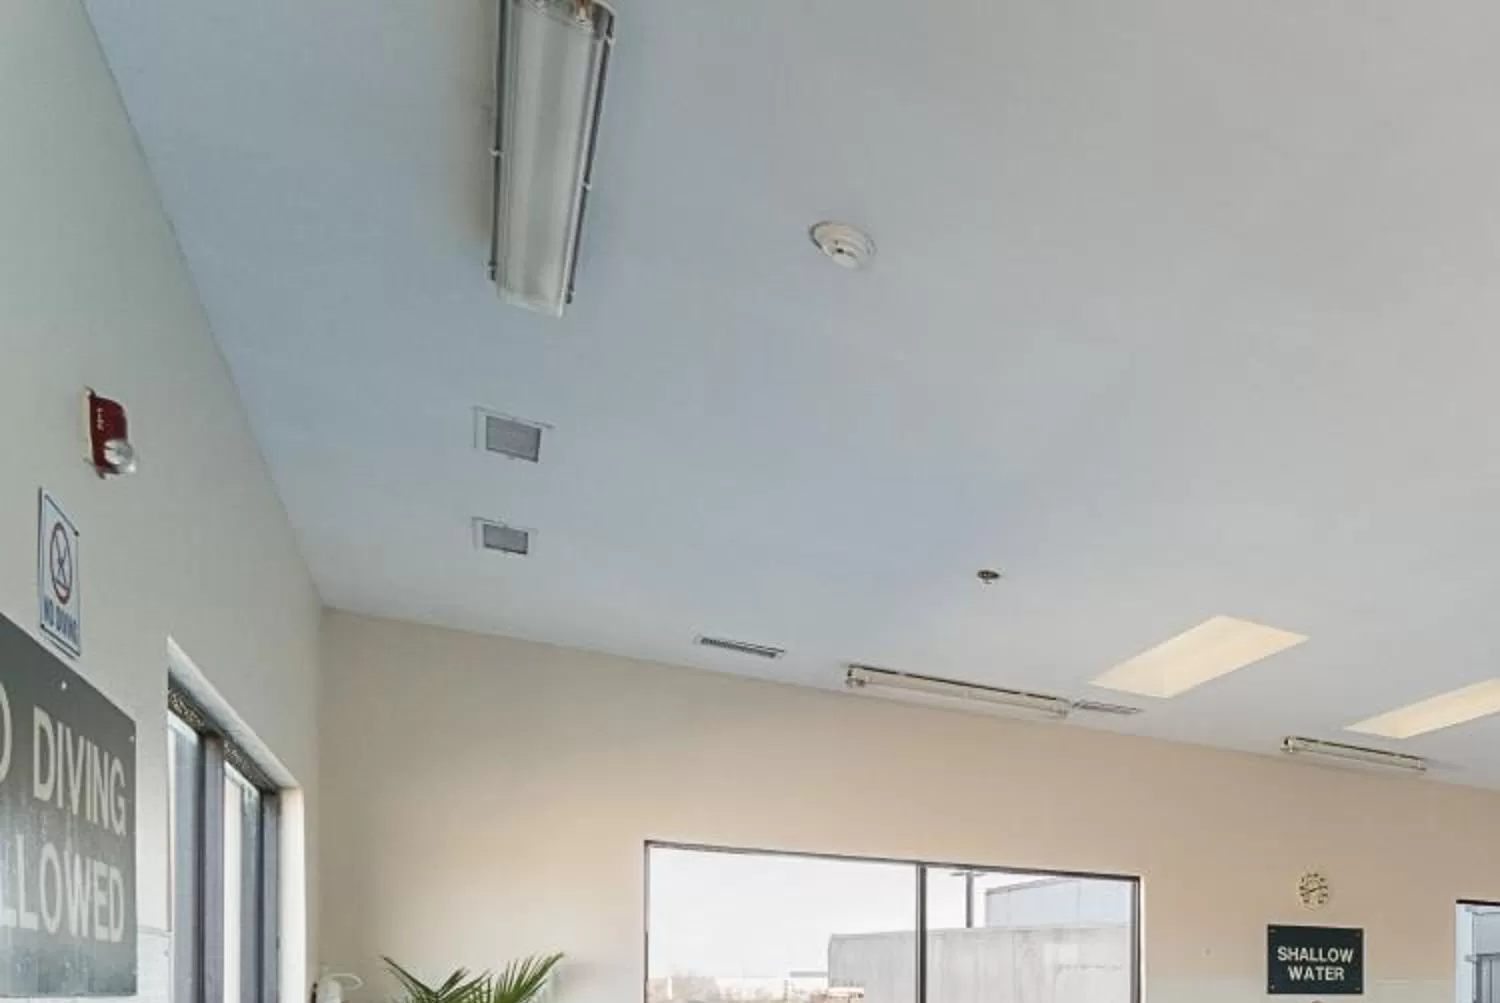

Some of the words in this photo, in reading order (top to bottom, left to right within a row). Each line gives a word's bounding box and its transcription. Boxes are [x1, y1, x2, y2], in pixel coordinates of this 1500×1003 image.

[33, 704, 127, 837] DIVING
[1277, 945, 1354, 963] SHALLOW
[1288, 966, 1345, 982] WATER
